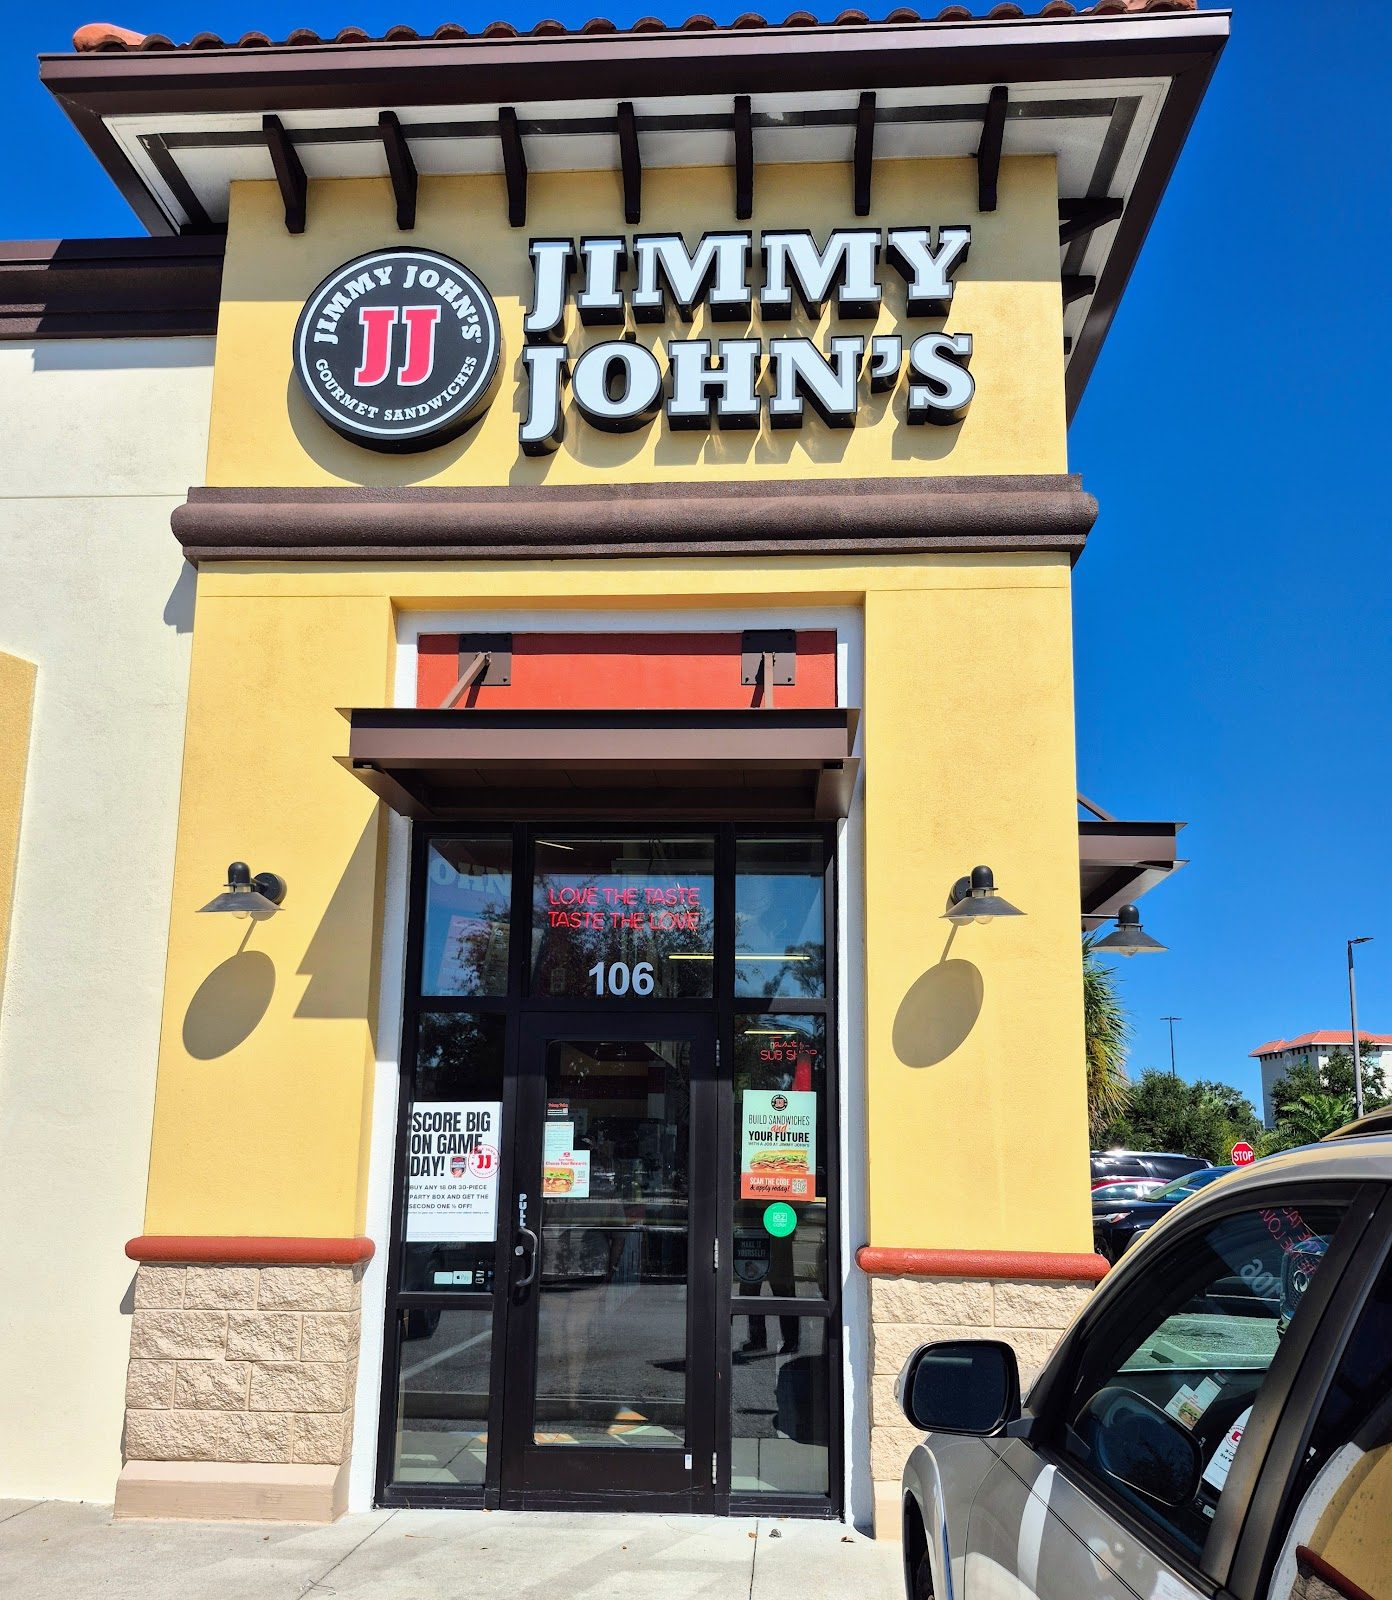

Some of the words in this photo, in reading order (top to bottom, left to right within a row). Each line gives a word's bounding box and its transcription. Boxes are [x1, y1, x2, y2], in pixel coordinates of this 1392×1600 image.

[525, 230, 971, 333] JIMMY
[314, 265, 393, 345] JIMMY
[403, 265, 482, 341] JOHN'S
[354, 305, 442, 386] JJ
[315, 358, 379, 419] GOURMET
[384, 356, 478, 421] SANDWICHES
[520, 333, 975, 442] JOHN'S
[549, 887, 599, 906] LOVE
[602, 887, 638, 905] THE
[644, 887, 700, 905] TASTE
[548, 911, 605, 930] TASTE
[609, 912, 645, 930] THE
[650, 911, 700, 931] LOVE
[588, 961, 655, 996] 106
[760, 1049, 783, 1061] SUB
[412, 1111, 462, 1132] SCORE
[466, 1111, 491, 1132] BIG
[748, 1114, 767, 1125] BUILD
[768, 1115, 810, 1126] SANDWICHES
[770, 1124, 788, 1133] and
[411, 1133, 433, 1155] ON
[436, 1133, 483, 1155] GAME
[748, 1130, 773, 1142] YOUR
[775, 1131, 810, 1143] FUTURE
[410, 1155, 446, 1177] DAY!
[477, 1154, 492, 1169] JJ
[1233, 1150, 1254, 1162] STOP
[749, 1177, 764, 1185] SCAN
[765, 1177, 775, 1185] THE
[775, 1178, 791, 1186] CODE
[755, 1185, 771, 1193] apply
[519, 1193, 528, 1227] PULL
